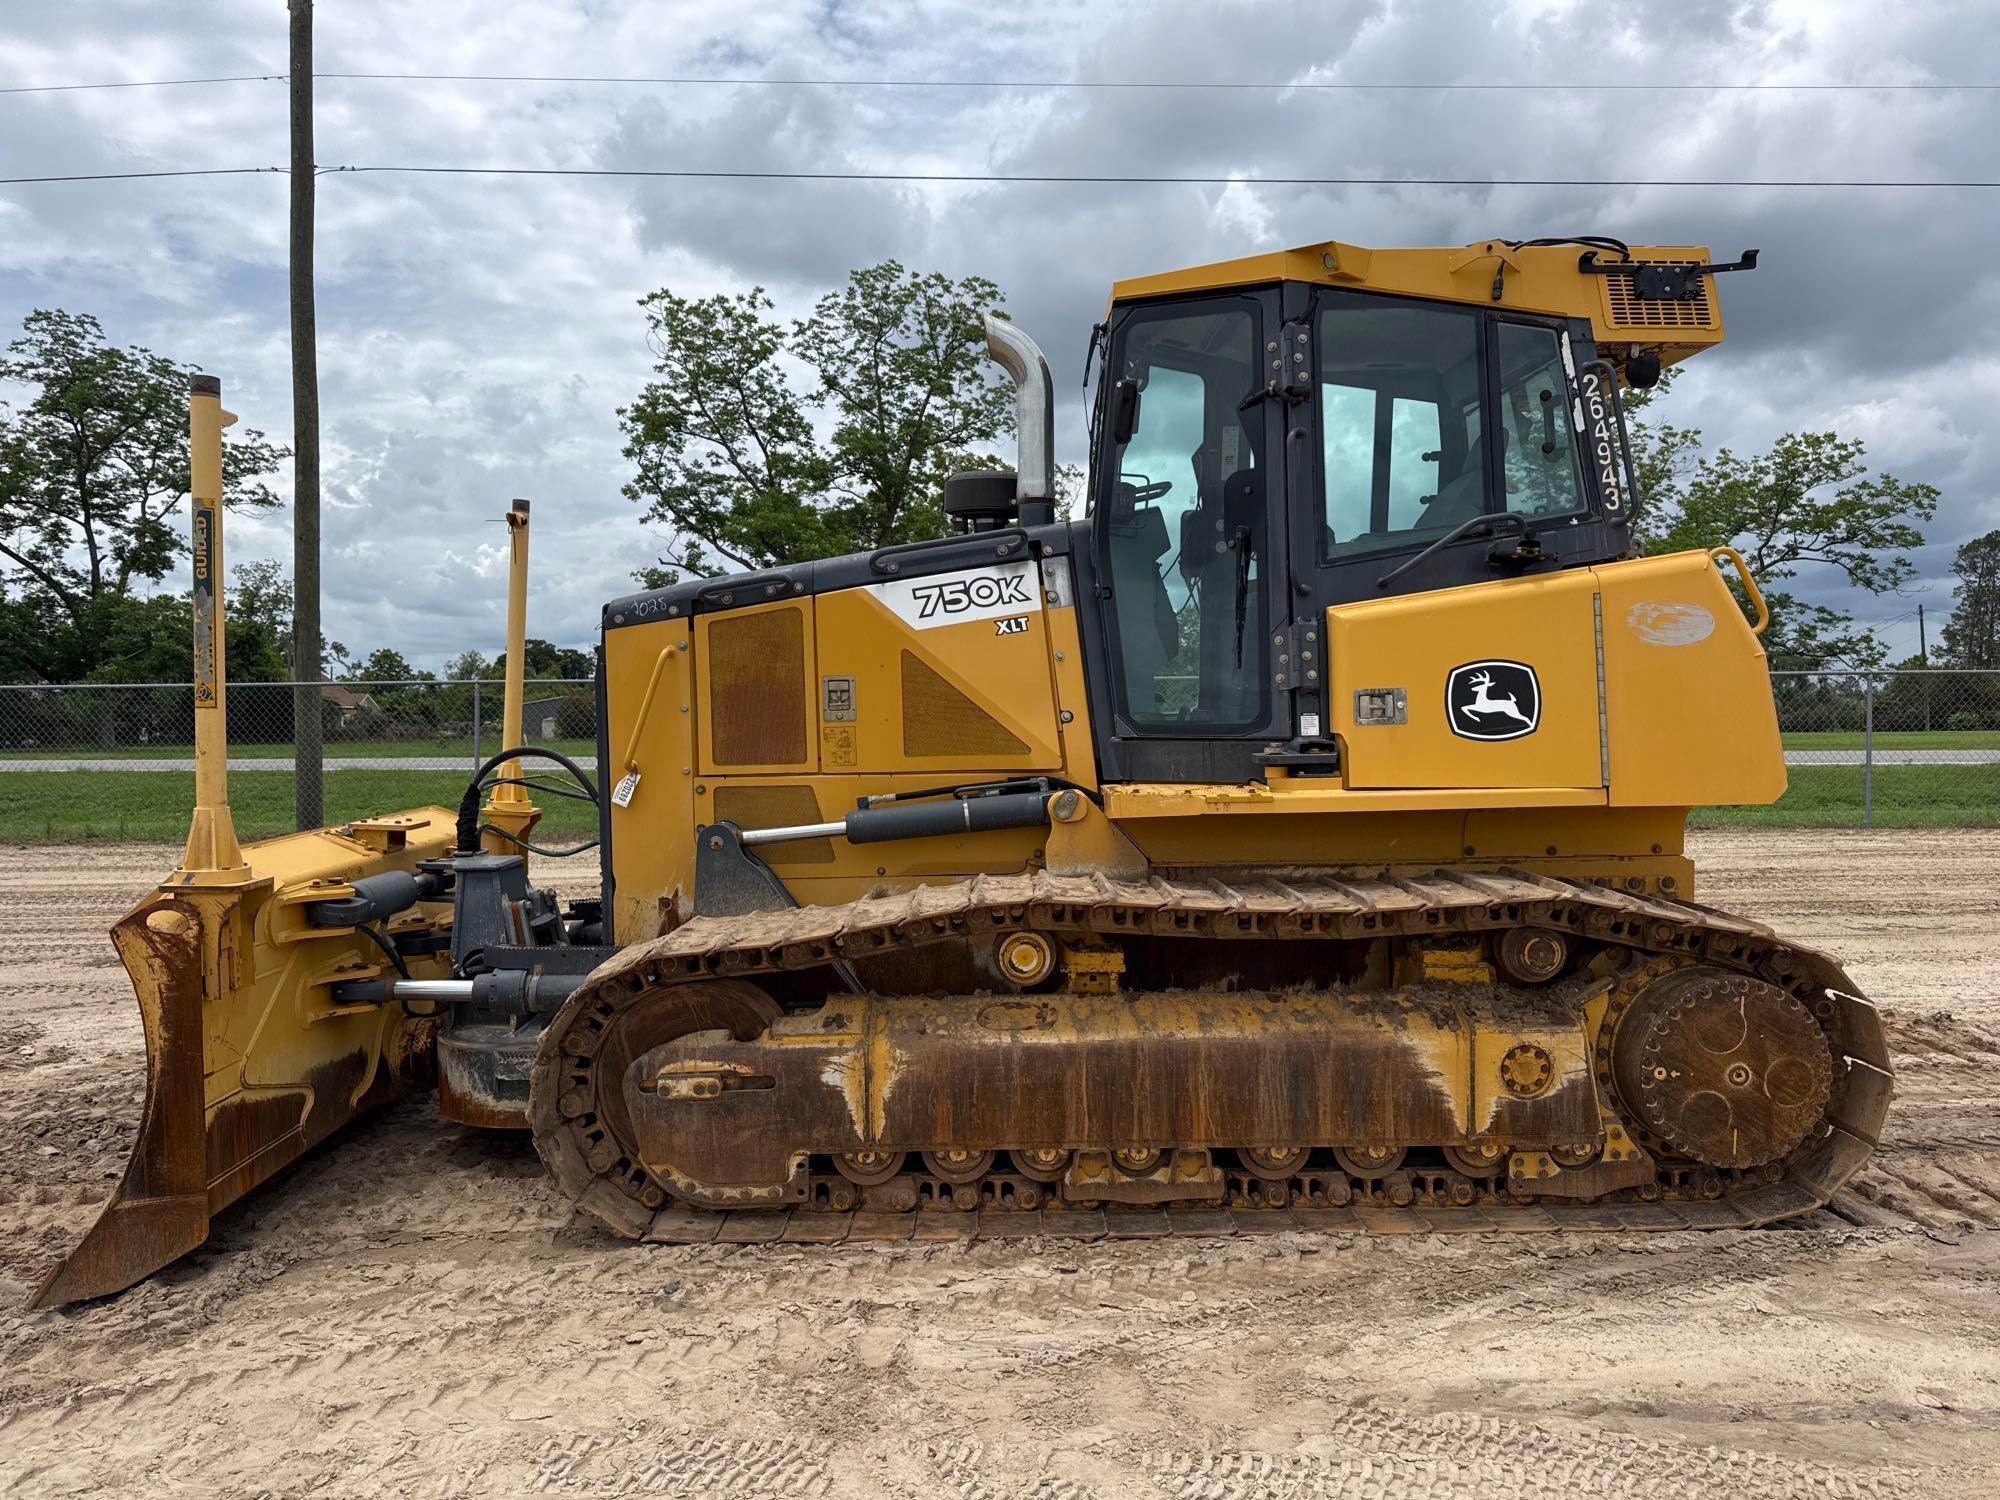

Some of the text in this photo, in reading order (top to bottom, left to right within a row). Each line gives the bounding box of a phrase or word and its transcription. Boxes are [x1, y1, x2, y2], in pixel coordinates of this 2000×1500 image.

[1582, 374, 1620, 510] 264943
[912, 574, 1031, 618] 750K
[993, 616, 1029, 636] XLT
[618, 777, 635, 803] 220289
